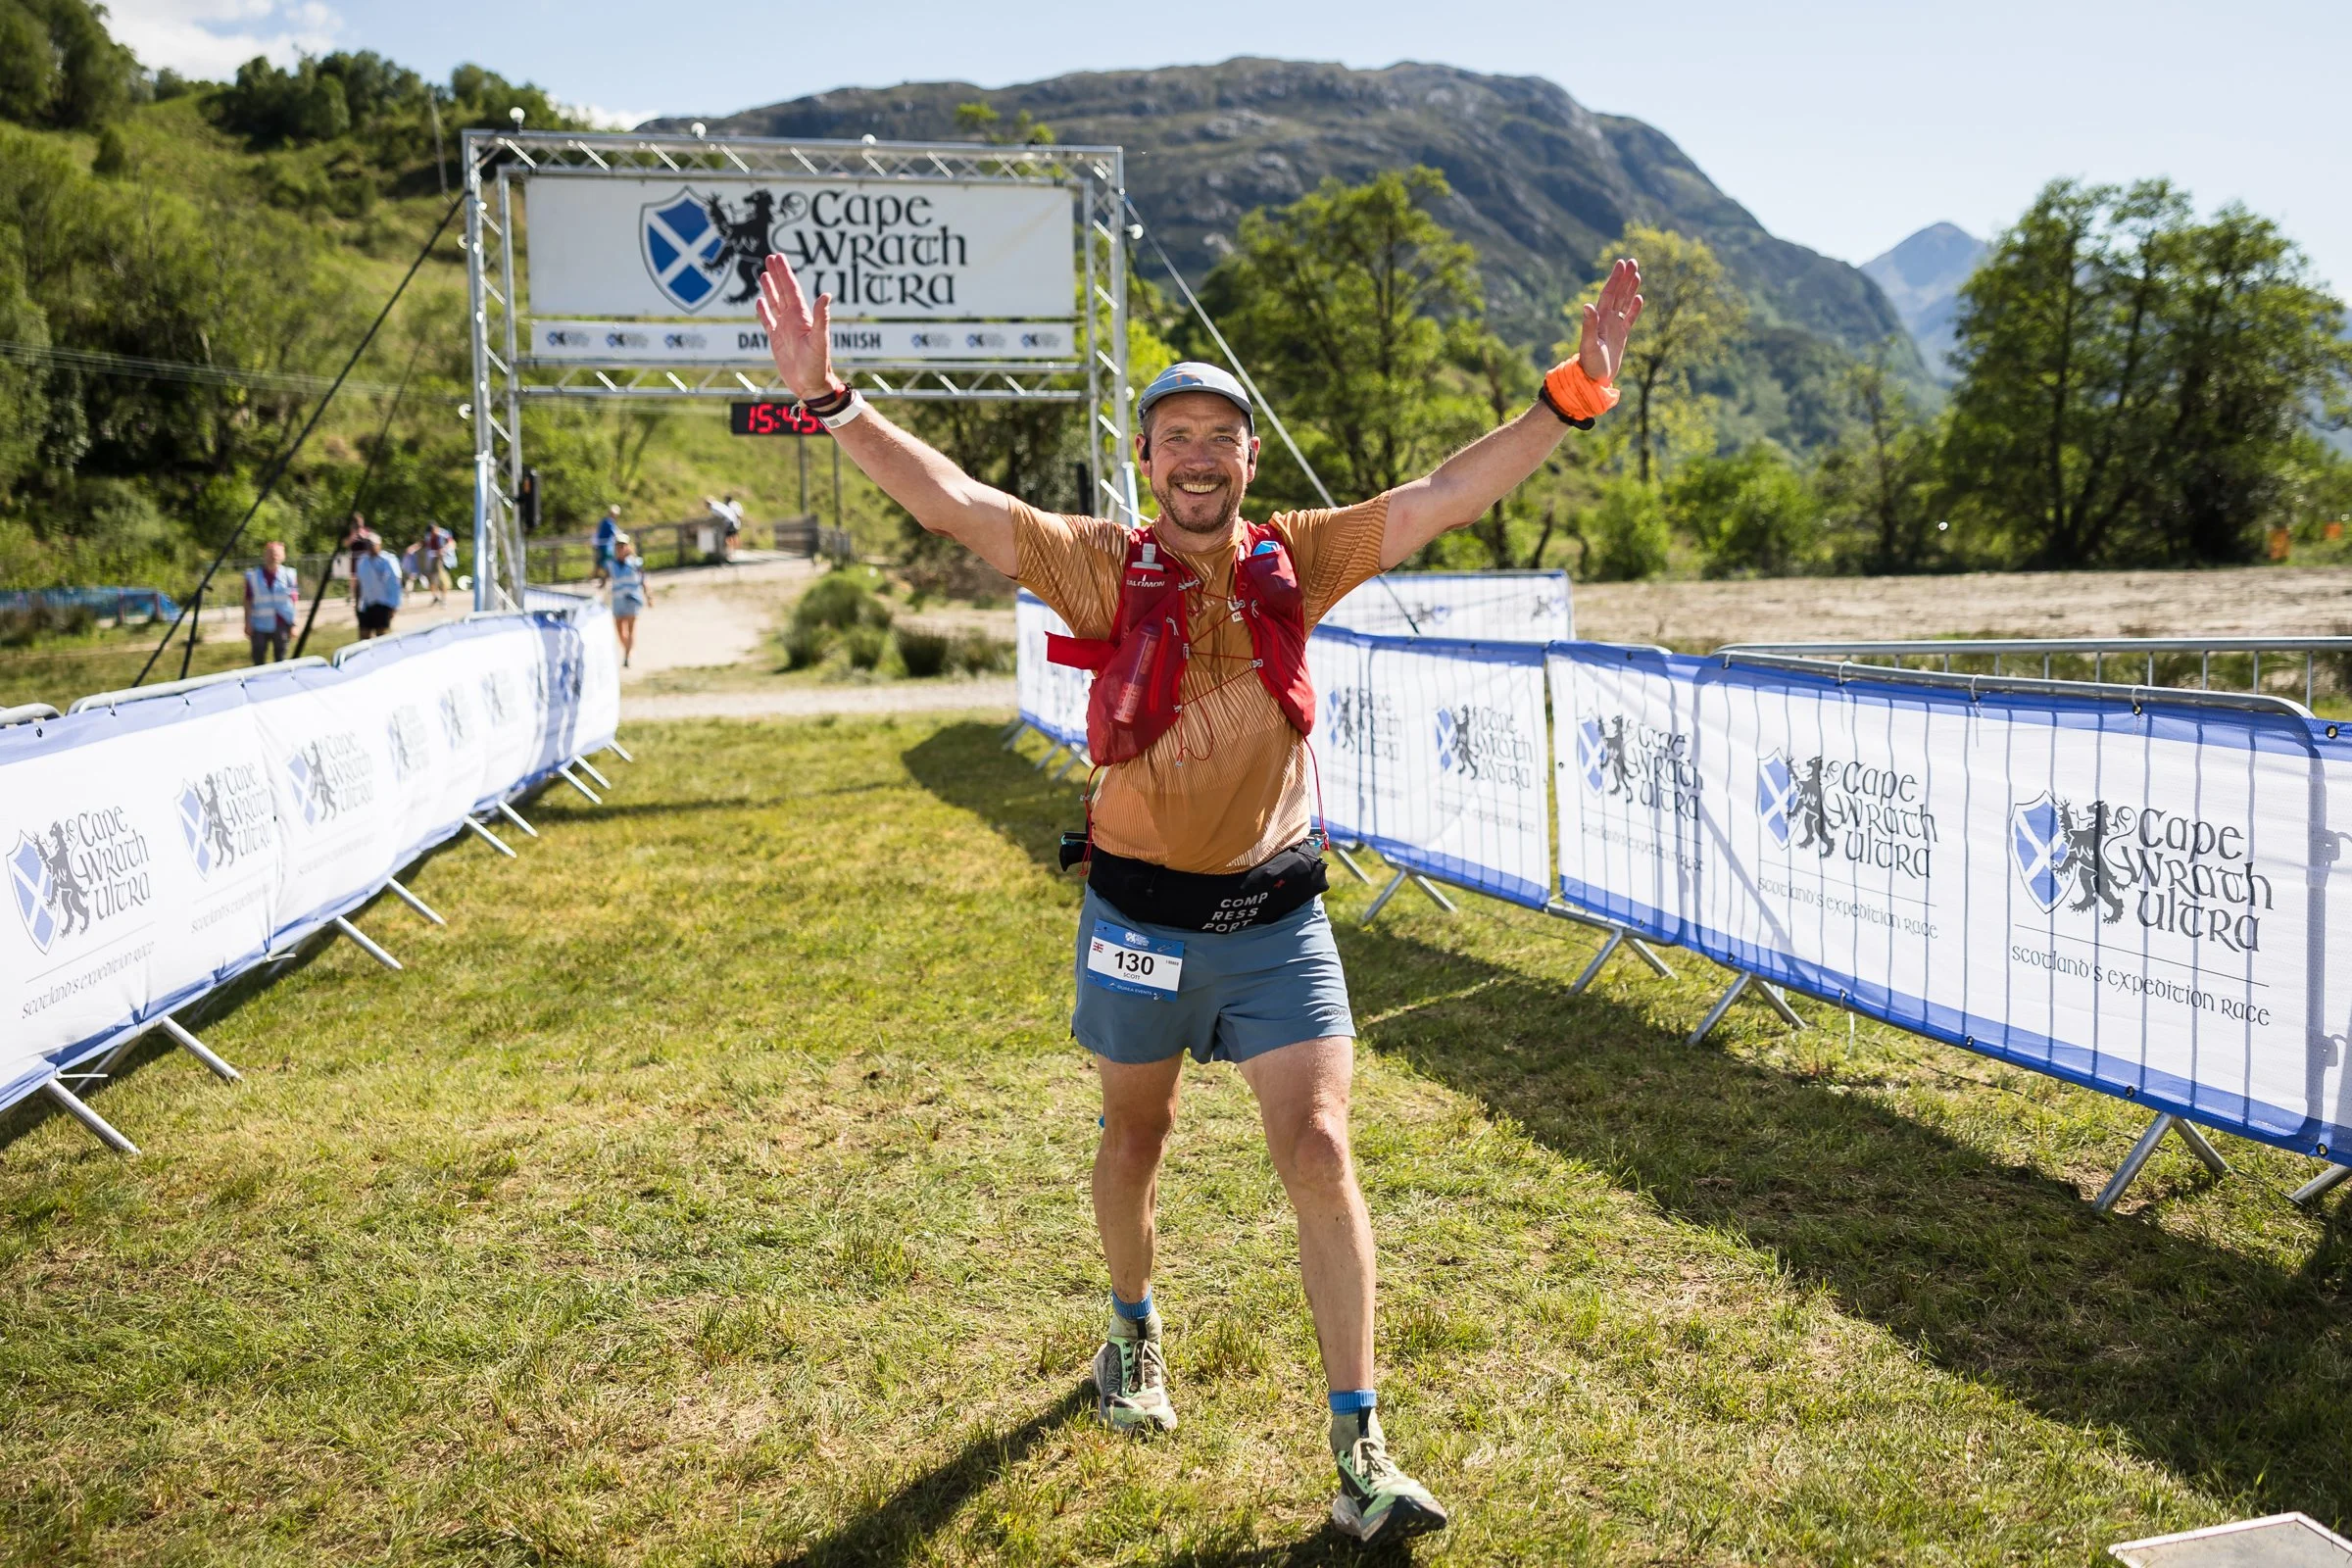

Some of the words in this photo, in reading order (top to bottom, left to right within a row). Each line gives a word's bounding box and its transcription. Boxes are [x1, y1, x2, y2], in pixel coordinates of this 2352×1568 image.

[810, 189, 933, 235] Cape
[794, 224, 969, 270] Wrath
[814, 259, 956, 310] Ultra
[738, 332, 768, 349] DAY
[834, 332, 882, 349] INISH
[224, 762, 258, 796] Cape
[1632, 747, 1703, 790] Wrath
[1842, 760, 1919, 806] Cape
[1640, 780, 1699, 821] Ultra
[1836, 793, 1939, 843] Wrath
[77, 806, 128, 847] Cape
[2138, 808, 2244, 863] Cape
[79, 828, 150, 886] Wrath
[1844, 827, 1932, 879] Ultra
[94, 871, 151, 921] Ultra
[1220, 892, 1268, 908] COMP
[2121, 846, 2274, 910] Wrath
[1201, 918, 1253, 933] PORT
[1211, 907, 1258, 921] RESS
[1826, 897, 1900, 929] expedition
[2136, 886, 2261, 953] Ultra
[1114, 951, 1154, 975] 130
[2012, 945, 2103, 982] scotland's
[2107, 968, 2215, 1011] expedition
